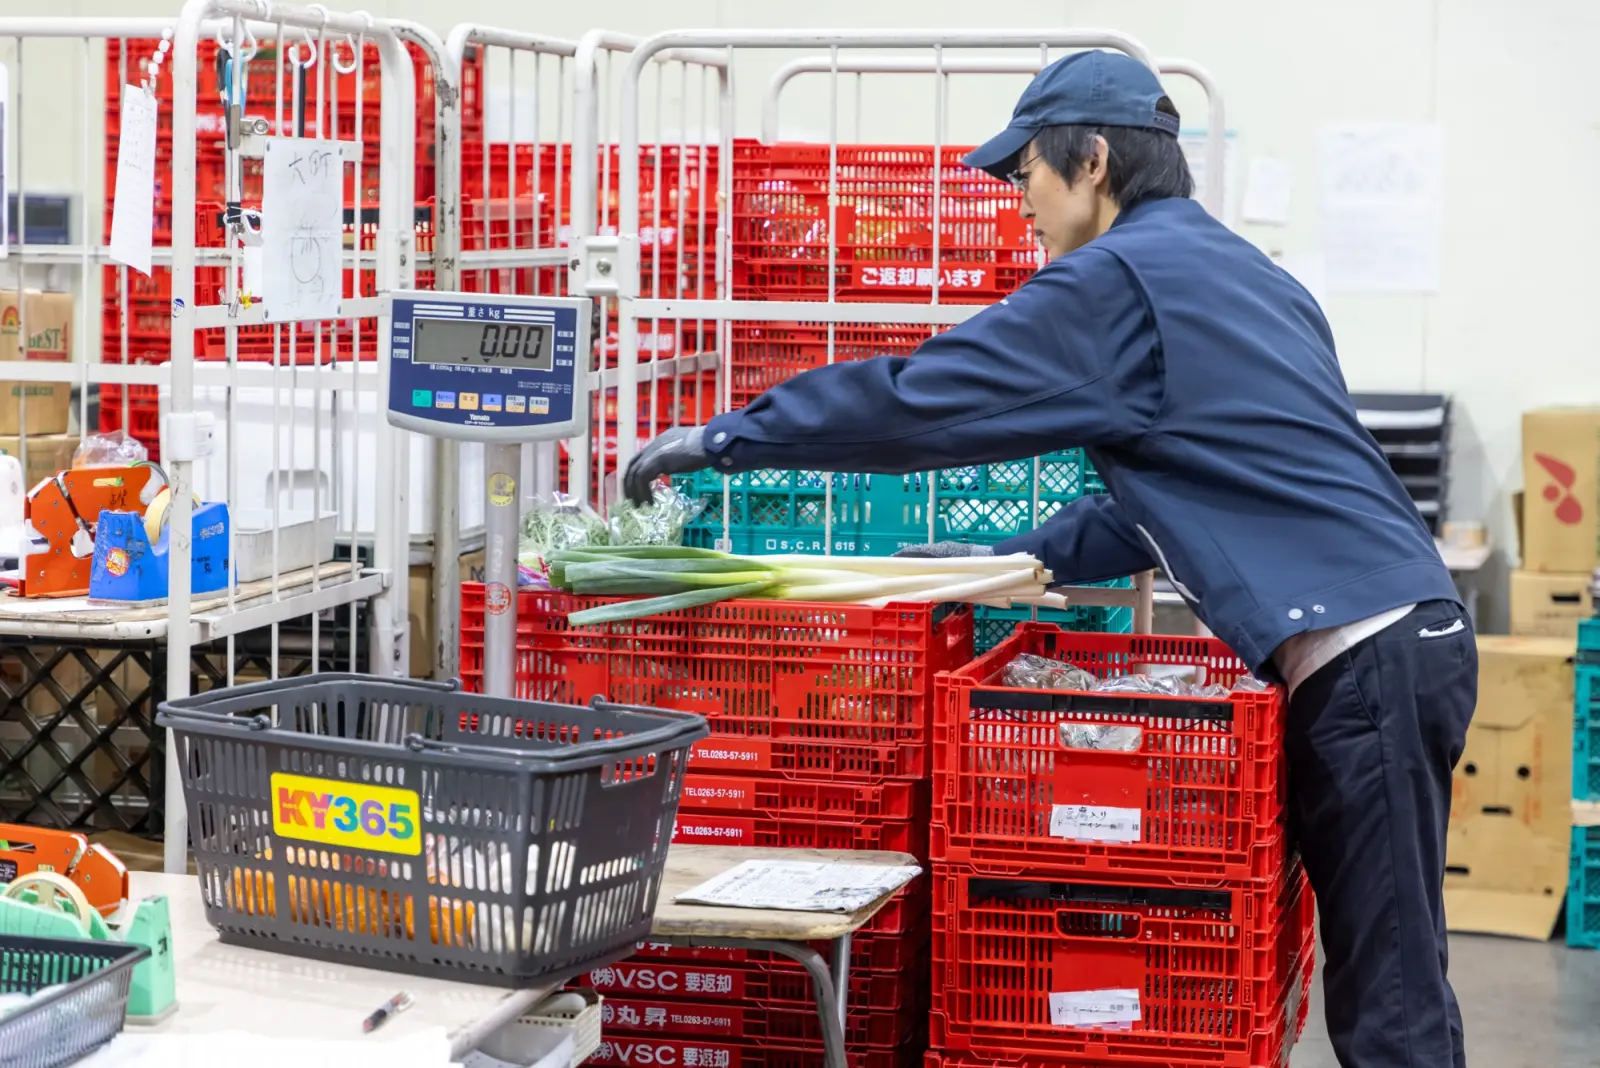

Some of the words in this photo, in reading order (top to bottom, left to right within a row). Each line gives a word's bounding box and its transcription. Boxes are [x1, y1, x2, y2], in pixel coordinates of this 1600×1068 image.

[861, 267, 986, 288] ご返却願います
[489, 308, 500, 319] kg
[479, 324, 544, 359] 0.00
[780, 541, 826, 551] S.C.R.
[835, 541, 855, 551] 615
[697, 749, 758, 761] TEL0263-57-5911
[685, 787, 745, 798] TEL0263-57-5911
[278, 787, 414, 840] KY365
[682, 826, 742, 838] TEL0263-57-5911
[685, 973, 732, 993] 要返却
[671, 1014, 731, 1027] TEL0263-57-5911
[683, 1048, 729, 1068] 要返却
